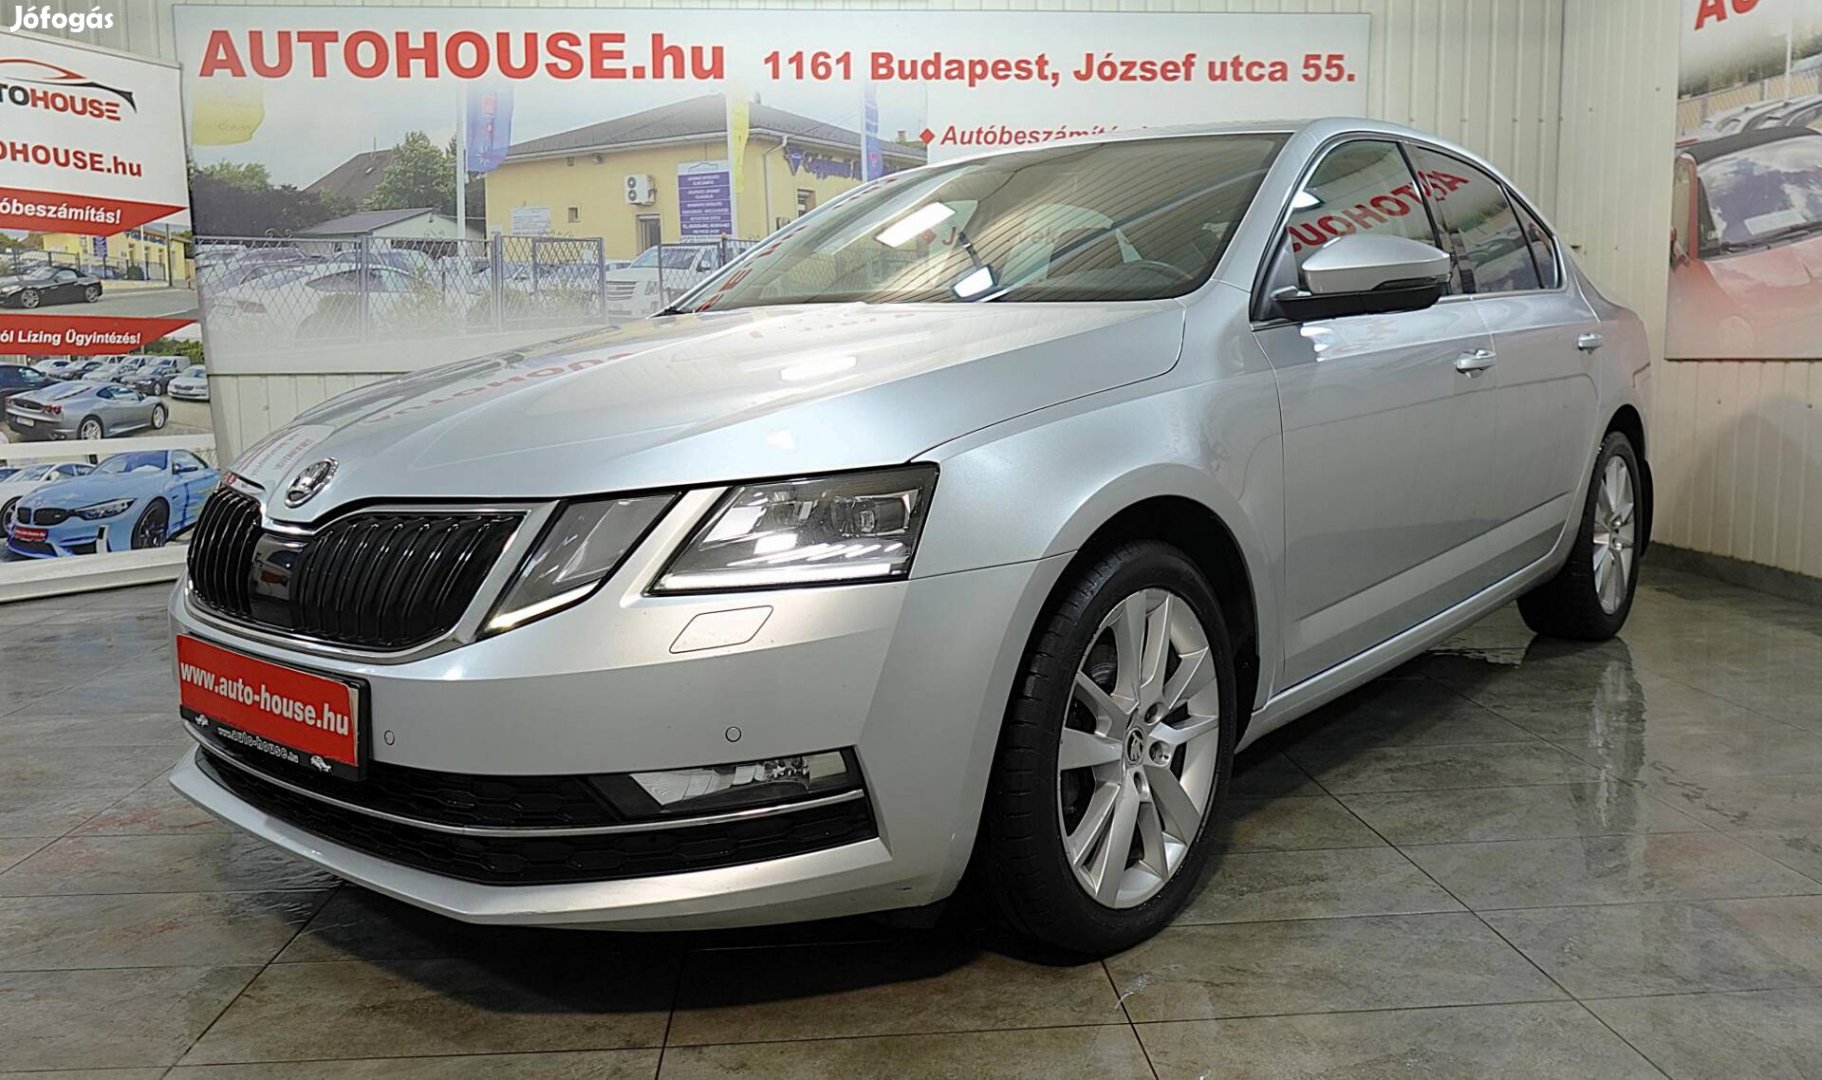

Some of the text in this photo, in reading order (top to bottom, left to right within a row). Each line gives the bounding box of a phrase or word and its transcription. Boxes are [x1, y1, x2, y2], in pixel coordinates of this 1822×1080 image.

[200, 29, 725, 81] AUTOHOUSE.hu
[764, 50, 1355, 88] 1161 Budapest, József utca 55.
[17, 330, 62, 347] Lízing
[65, 329, 142, 347] Ügyintézés!
[181, 662, 349, 736] www.auto-house.hu
